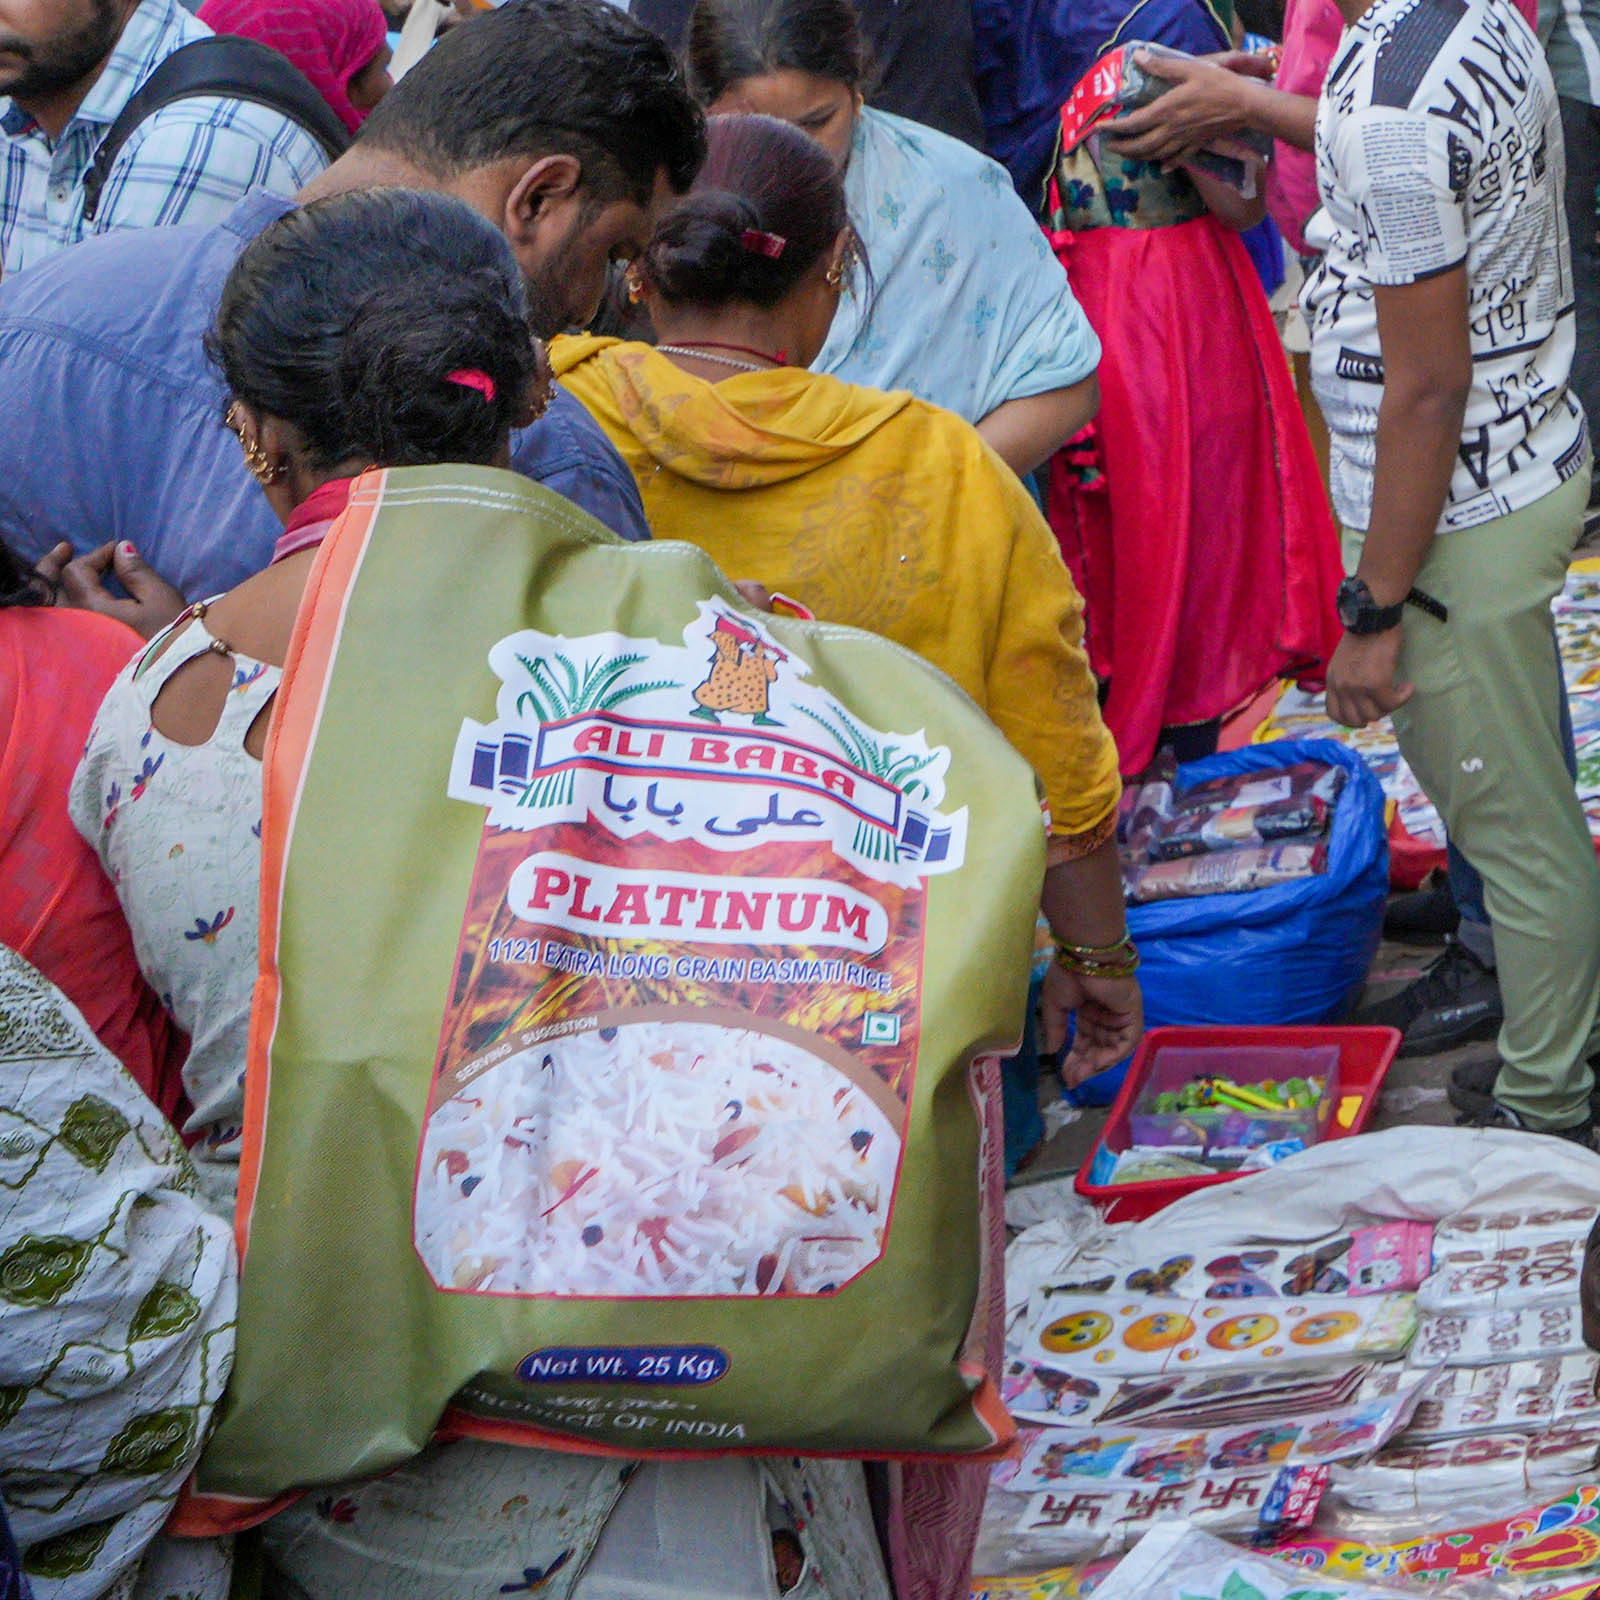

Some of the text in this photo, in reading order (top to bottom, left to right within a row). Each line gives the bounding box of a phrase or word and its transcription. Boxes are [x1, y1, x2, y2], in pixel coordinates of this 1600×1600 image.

[573, 725, 856, 800] ALI BABA
[603, 773, 685, 826] بابا
[527, 866, 872, 944] PLATINUM
[487, 937, 894, 995] 1121 EXTRA LONG GRAIN BASMATI RICE
[455, 1015, 600, 1084] SERVING SUGGESTION
[528, 1354, 720, 1381] Net Wt. 25 Kg.
[663, 1418, 748, 1440] INDIA
